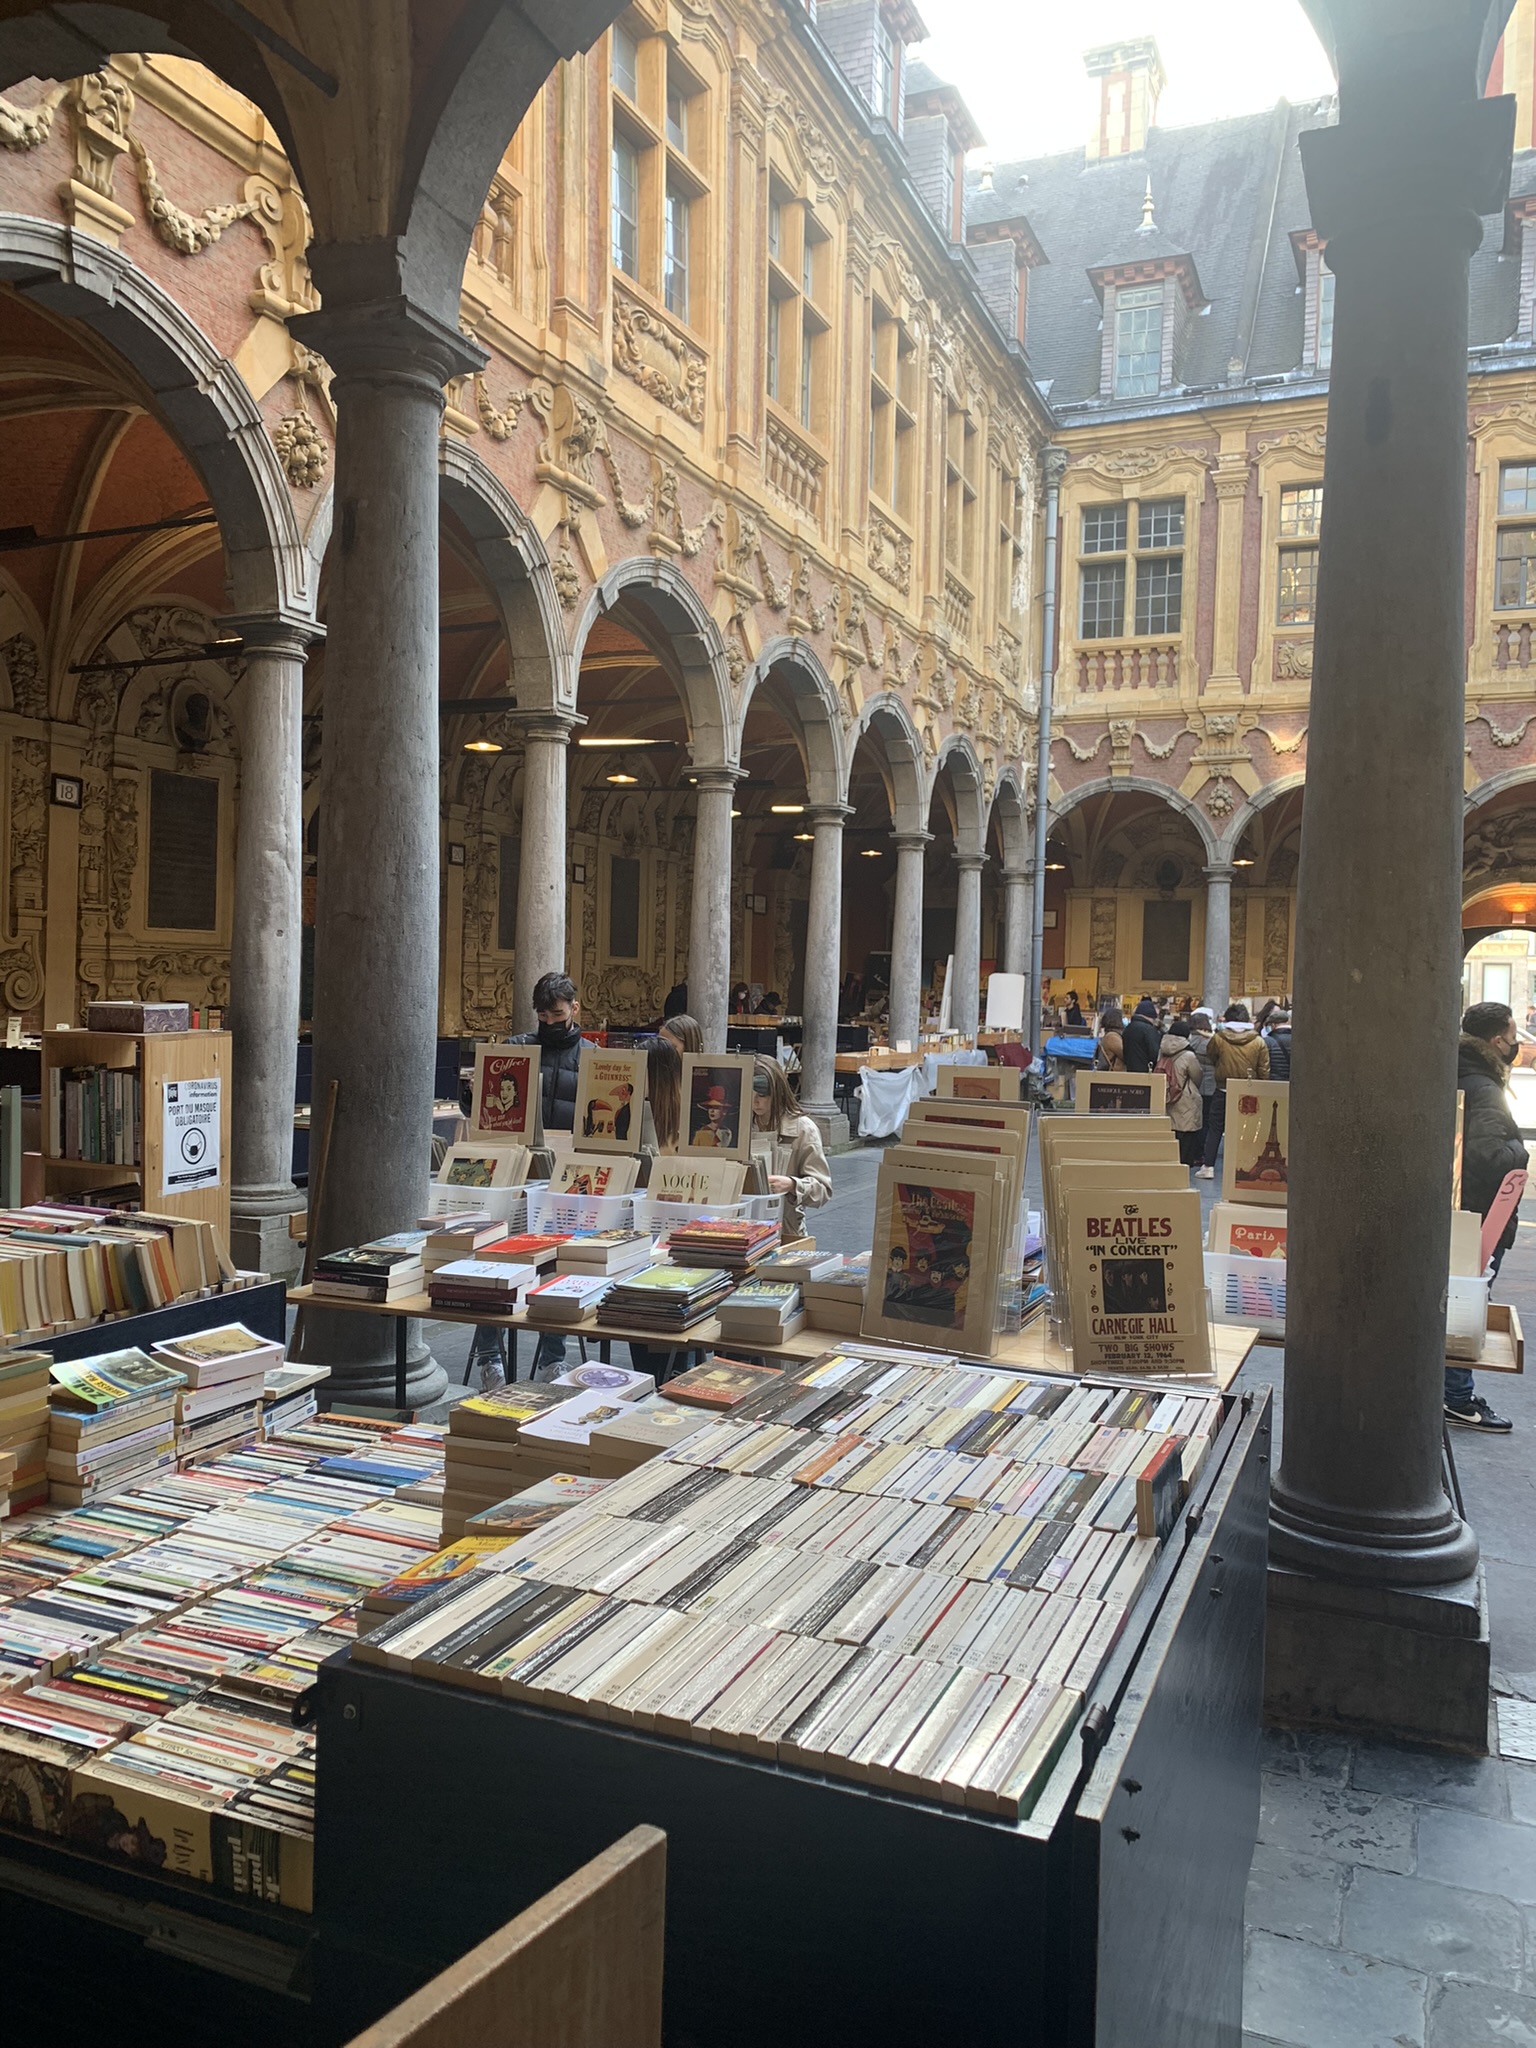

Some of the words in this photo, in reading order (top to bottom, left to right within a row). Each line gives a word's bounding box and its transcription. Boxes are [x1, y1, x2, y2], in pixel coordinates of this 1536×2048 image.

[61, 784, 73, 800] 18
[489, 1058, 527, 1075] Coffee!
[612, 1064, 621, 1072] day
[184, 1081, 218, 1090] CORONAVIRUS
[168, 1104, 184, 1116] PORT
[185, 1103, 193, 1114] DU
[194, 1102, 217, 1113] MASQUE
[175, 1113, 211, 1127] OBLIGATOIRE
[661, 1173, 710, 1190] VOGUE
[1123, 1204, 1139, 1215] The
[1086, 1217, 1172, 1238] BEATLES
[1234, 1227, 1275, 1242] Paris
[1115, 1237, 1147, 1245] LIVE
[1086, 1245, 1106, 1256] “IN
[1110, 1244, 1178, 1256] CONCERT”
[1092, 1318, 1144, 1335] CARNEGIE
[1149, 1317, 1178, 1334] HALL
[1098, 1344, 1119, 1353] TWO
[1125, 1343, 1139, 1352] BIG
[1144, 1343, 1175, 1352] SHOWS
